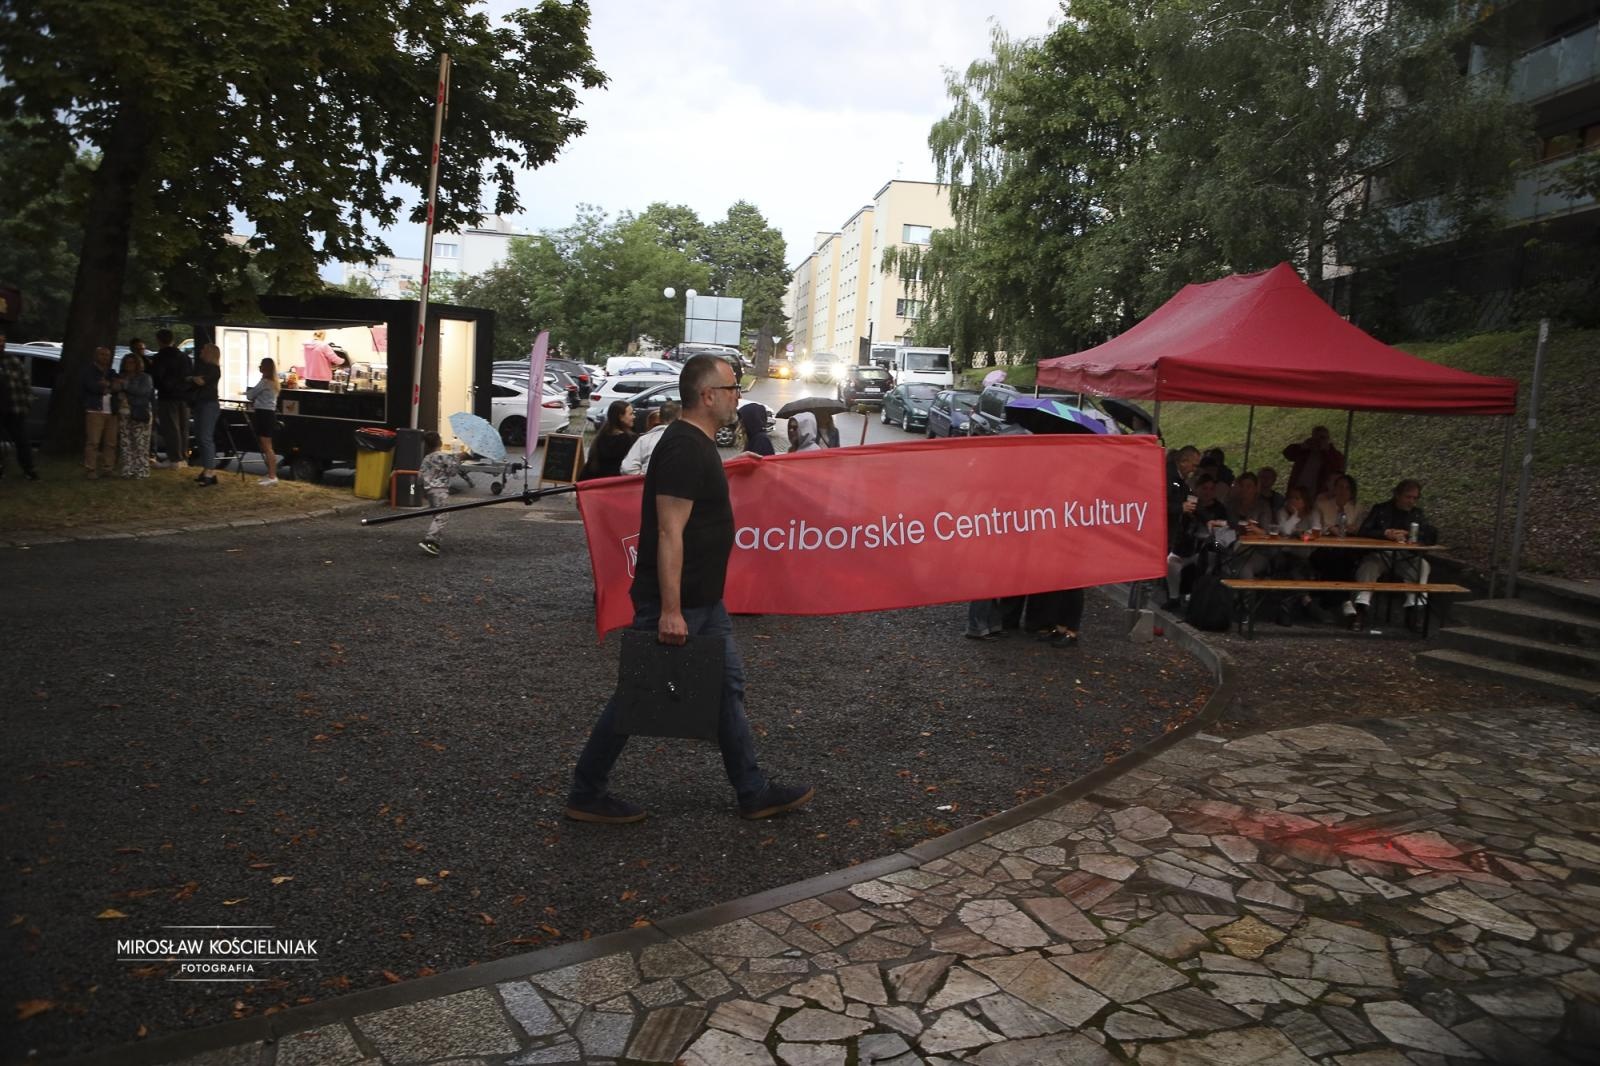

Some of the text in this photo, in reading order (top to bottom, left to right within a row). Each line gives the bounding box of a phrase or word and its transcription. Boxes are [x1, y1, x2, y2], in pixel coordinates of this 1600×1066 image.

[735, 498, 1148, 551] aciborskie Centrum Kultury
